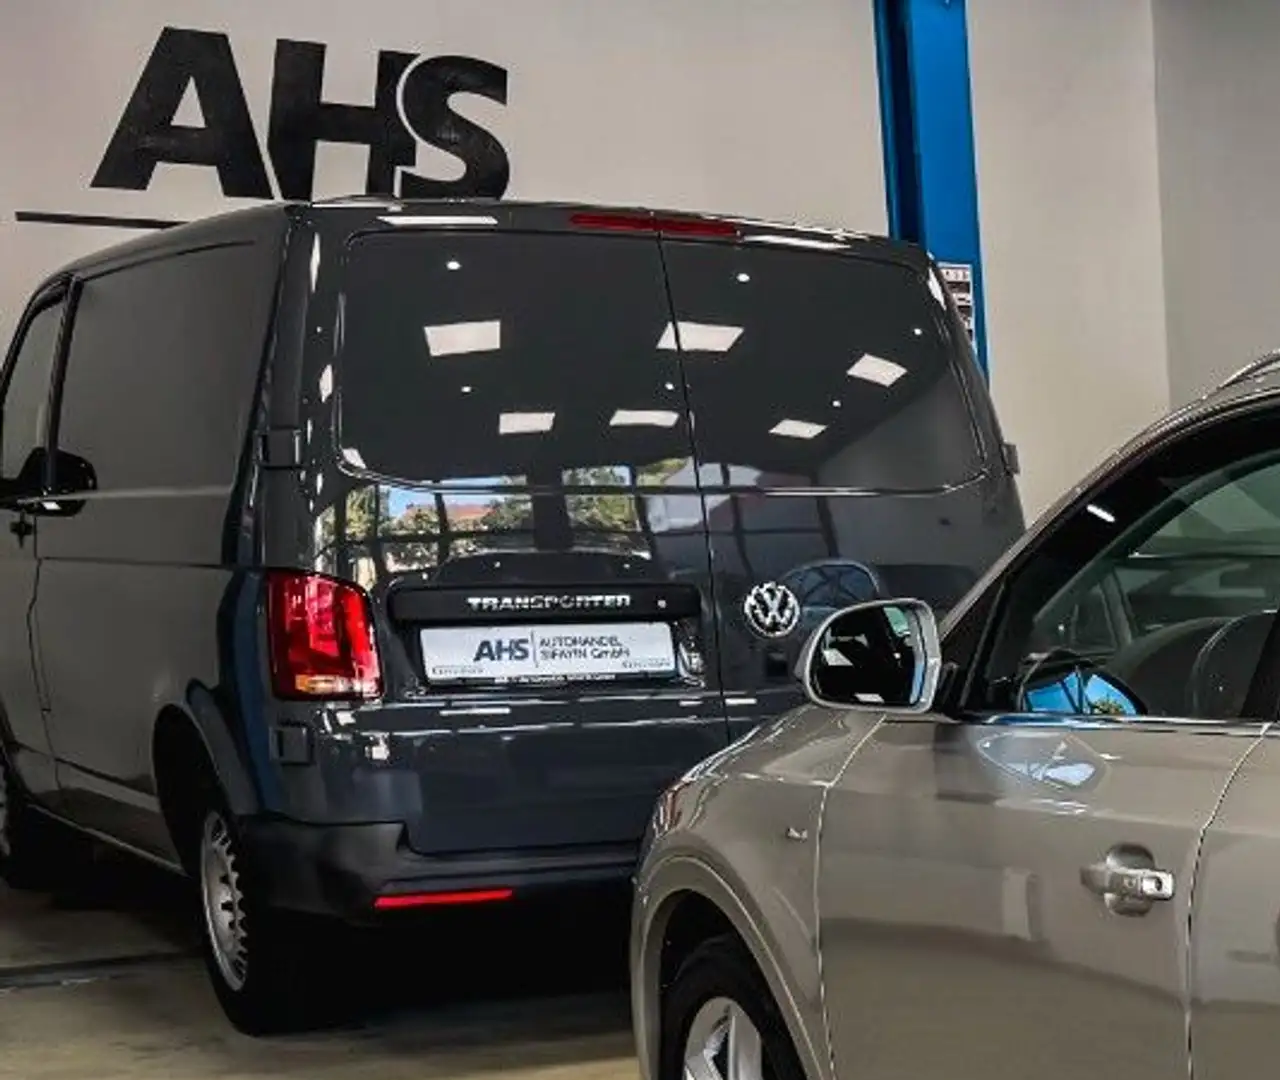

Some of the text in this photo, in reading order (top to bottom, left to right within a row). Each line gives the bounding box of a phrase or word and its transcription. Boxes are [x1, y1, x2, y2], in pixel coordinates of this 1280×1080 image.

[90, 26, 511, 201] AHS
[466, 594, 631, 612] TRANSPORTER
[473, 637, 529, 662] AHS
